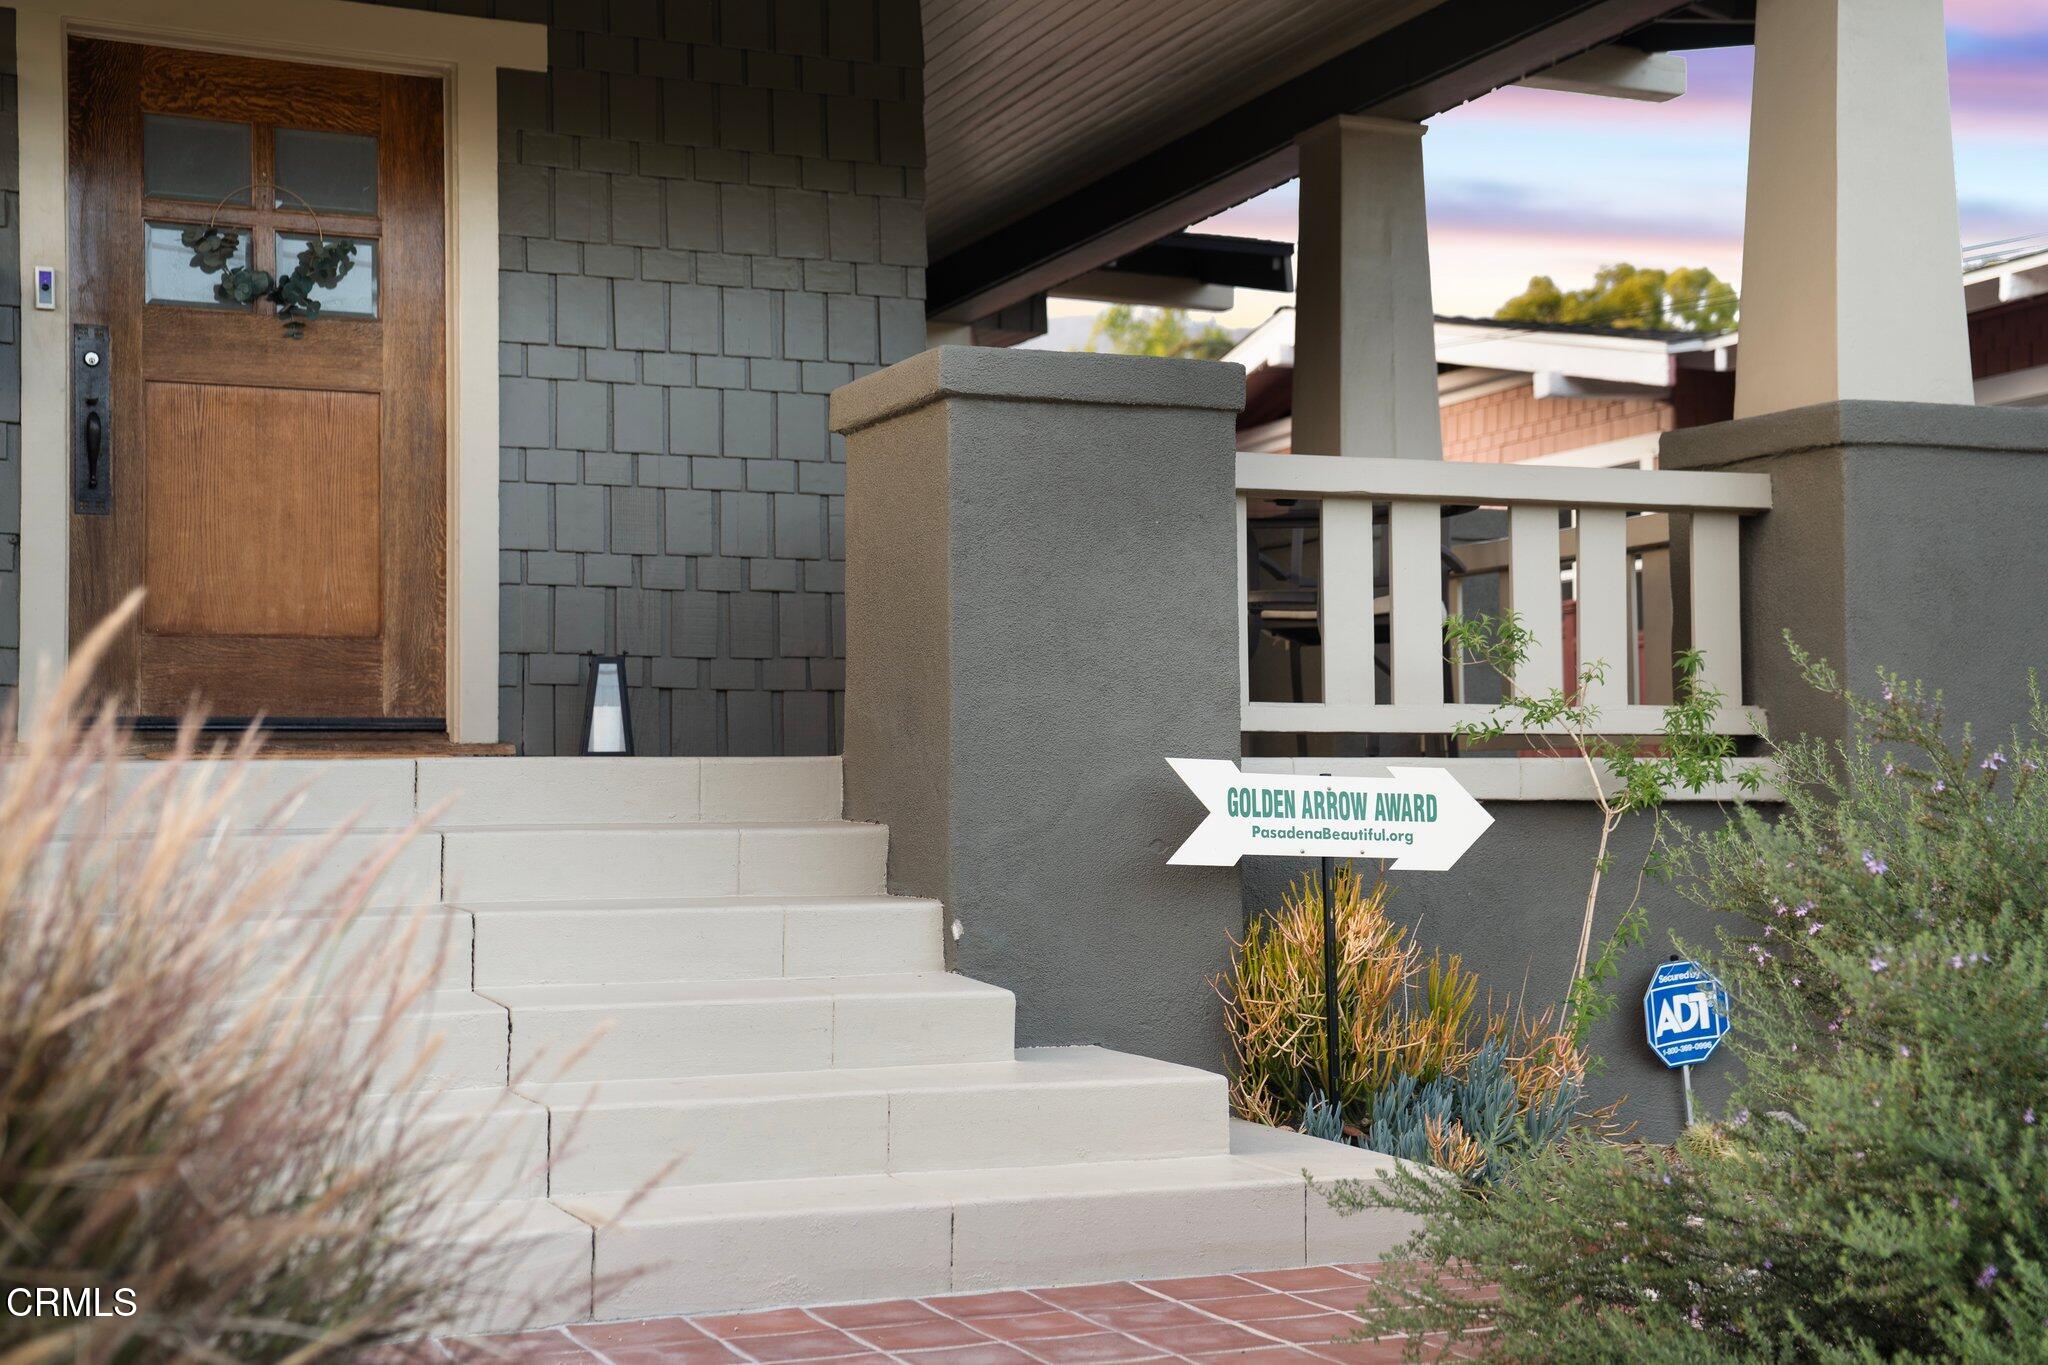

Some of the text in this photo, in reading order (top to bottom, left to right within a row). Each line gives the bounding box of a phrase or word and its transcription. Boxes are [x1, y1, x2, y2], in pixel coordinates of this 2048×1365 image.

[1227, 786, 1437, 822] GOLDEN ARROW AWARD
[1252, 825, 1414, 845] PasadenaBeautiful.org
[1658, 972, 1690, 983] Secured
[1656, 992, 1710, 1037] ADT
